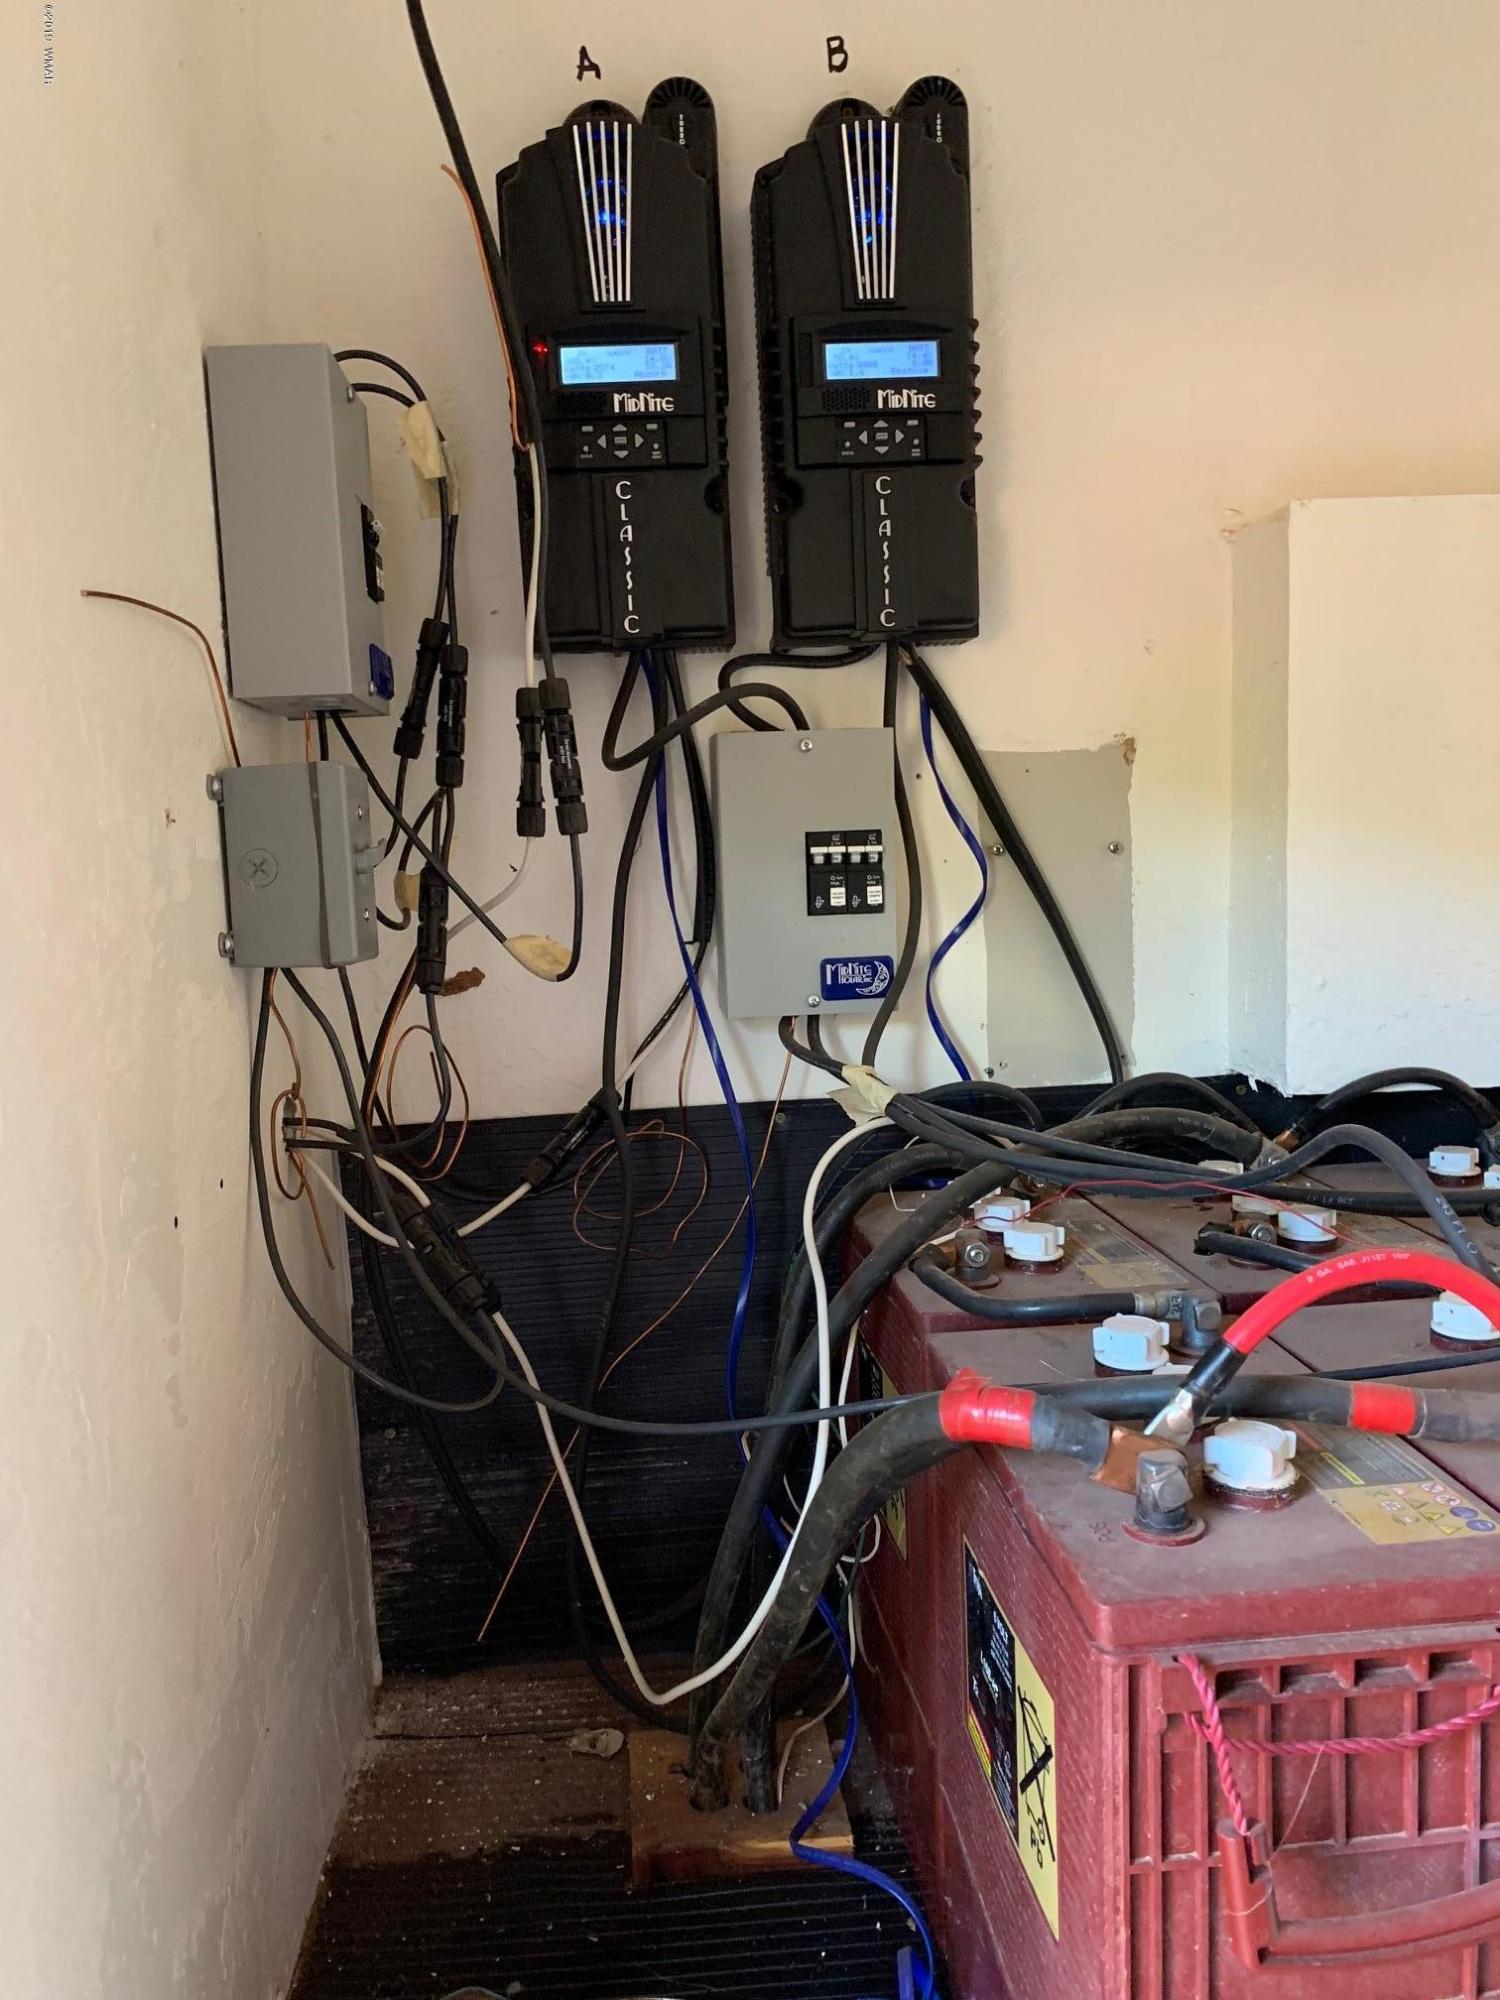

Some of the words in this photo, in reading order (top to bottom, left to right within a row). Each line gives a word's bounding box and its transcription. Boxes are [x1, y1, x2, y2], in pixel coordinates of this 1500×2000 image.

[576, 45, 601, 82] A
[826, 35, 849, 73] B
[615, 480, 640, 634] CLASSIC
[875, 476, 896, 627] CLASSIC
